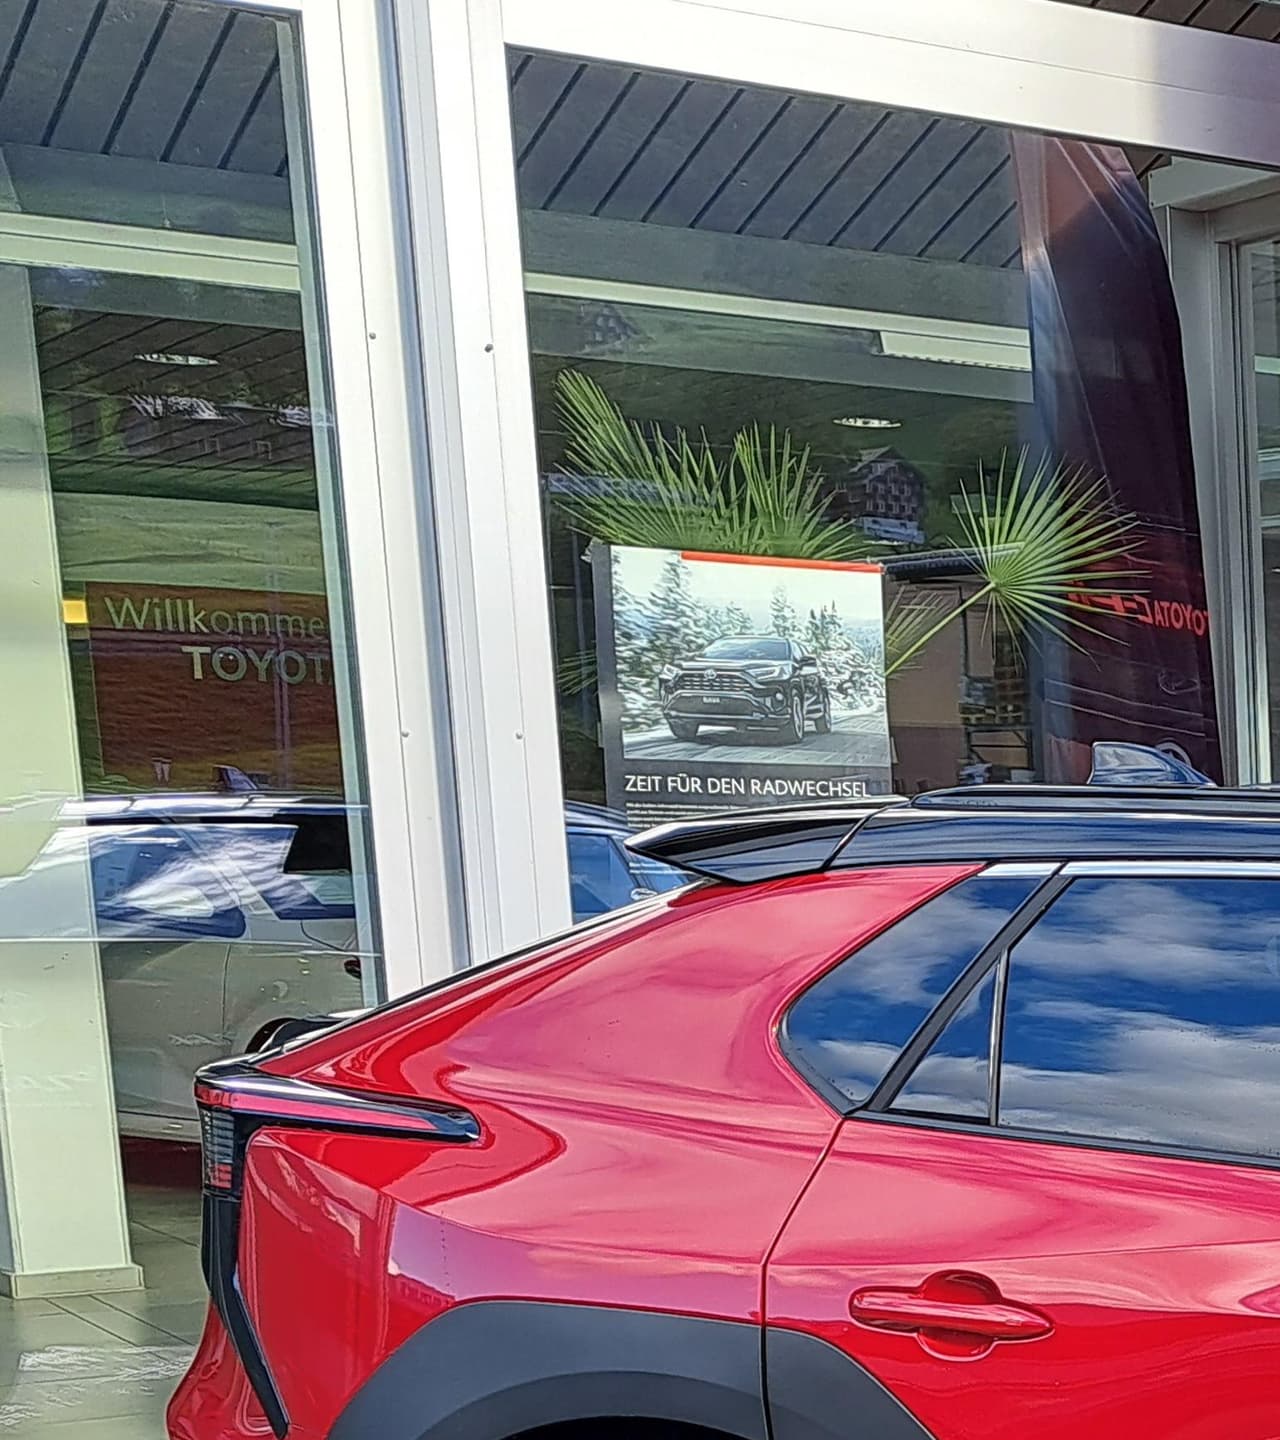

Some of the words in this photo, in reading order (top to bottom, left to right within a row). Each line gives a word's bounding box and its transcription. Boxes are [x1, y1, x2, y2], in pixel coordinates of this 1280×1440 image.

[182, 645, 332, 685] TOYOT
[624, 775, 662, 792] ZEIT
[667, 772, 703, 794] FÜR
[707, 777, 745, 795] DEN
[751, 777, 872, 798] RADWECHSEL
